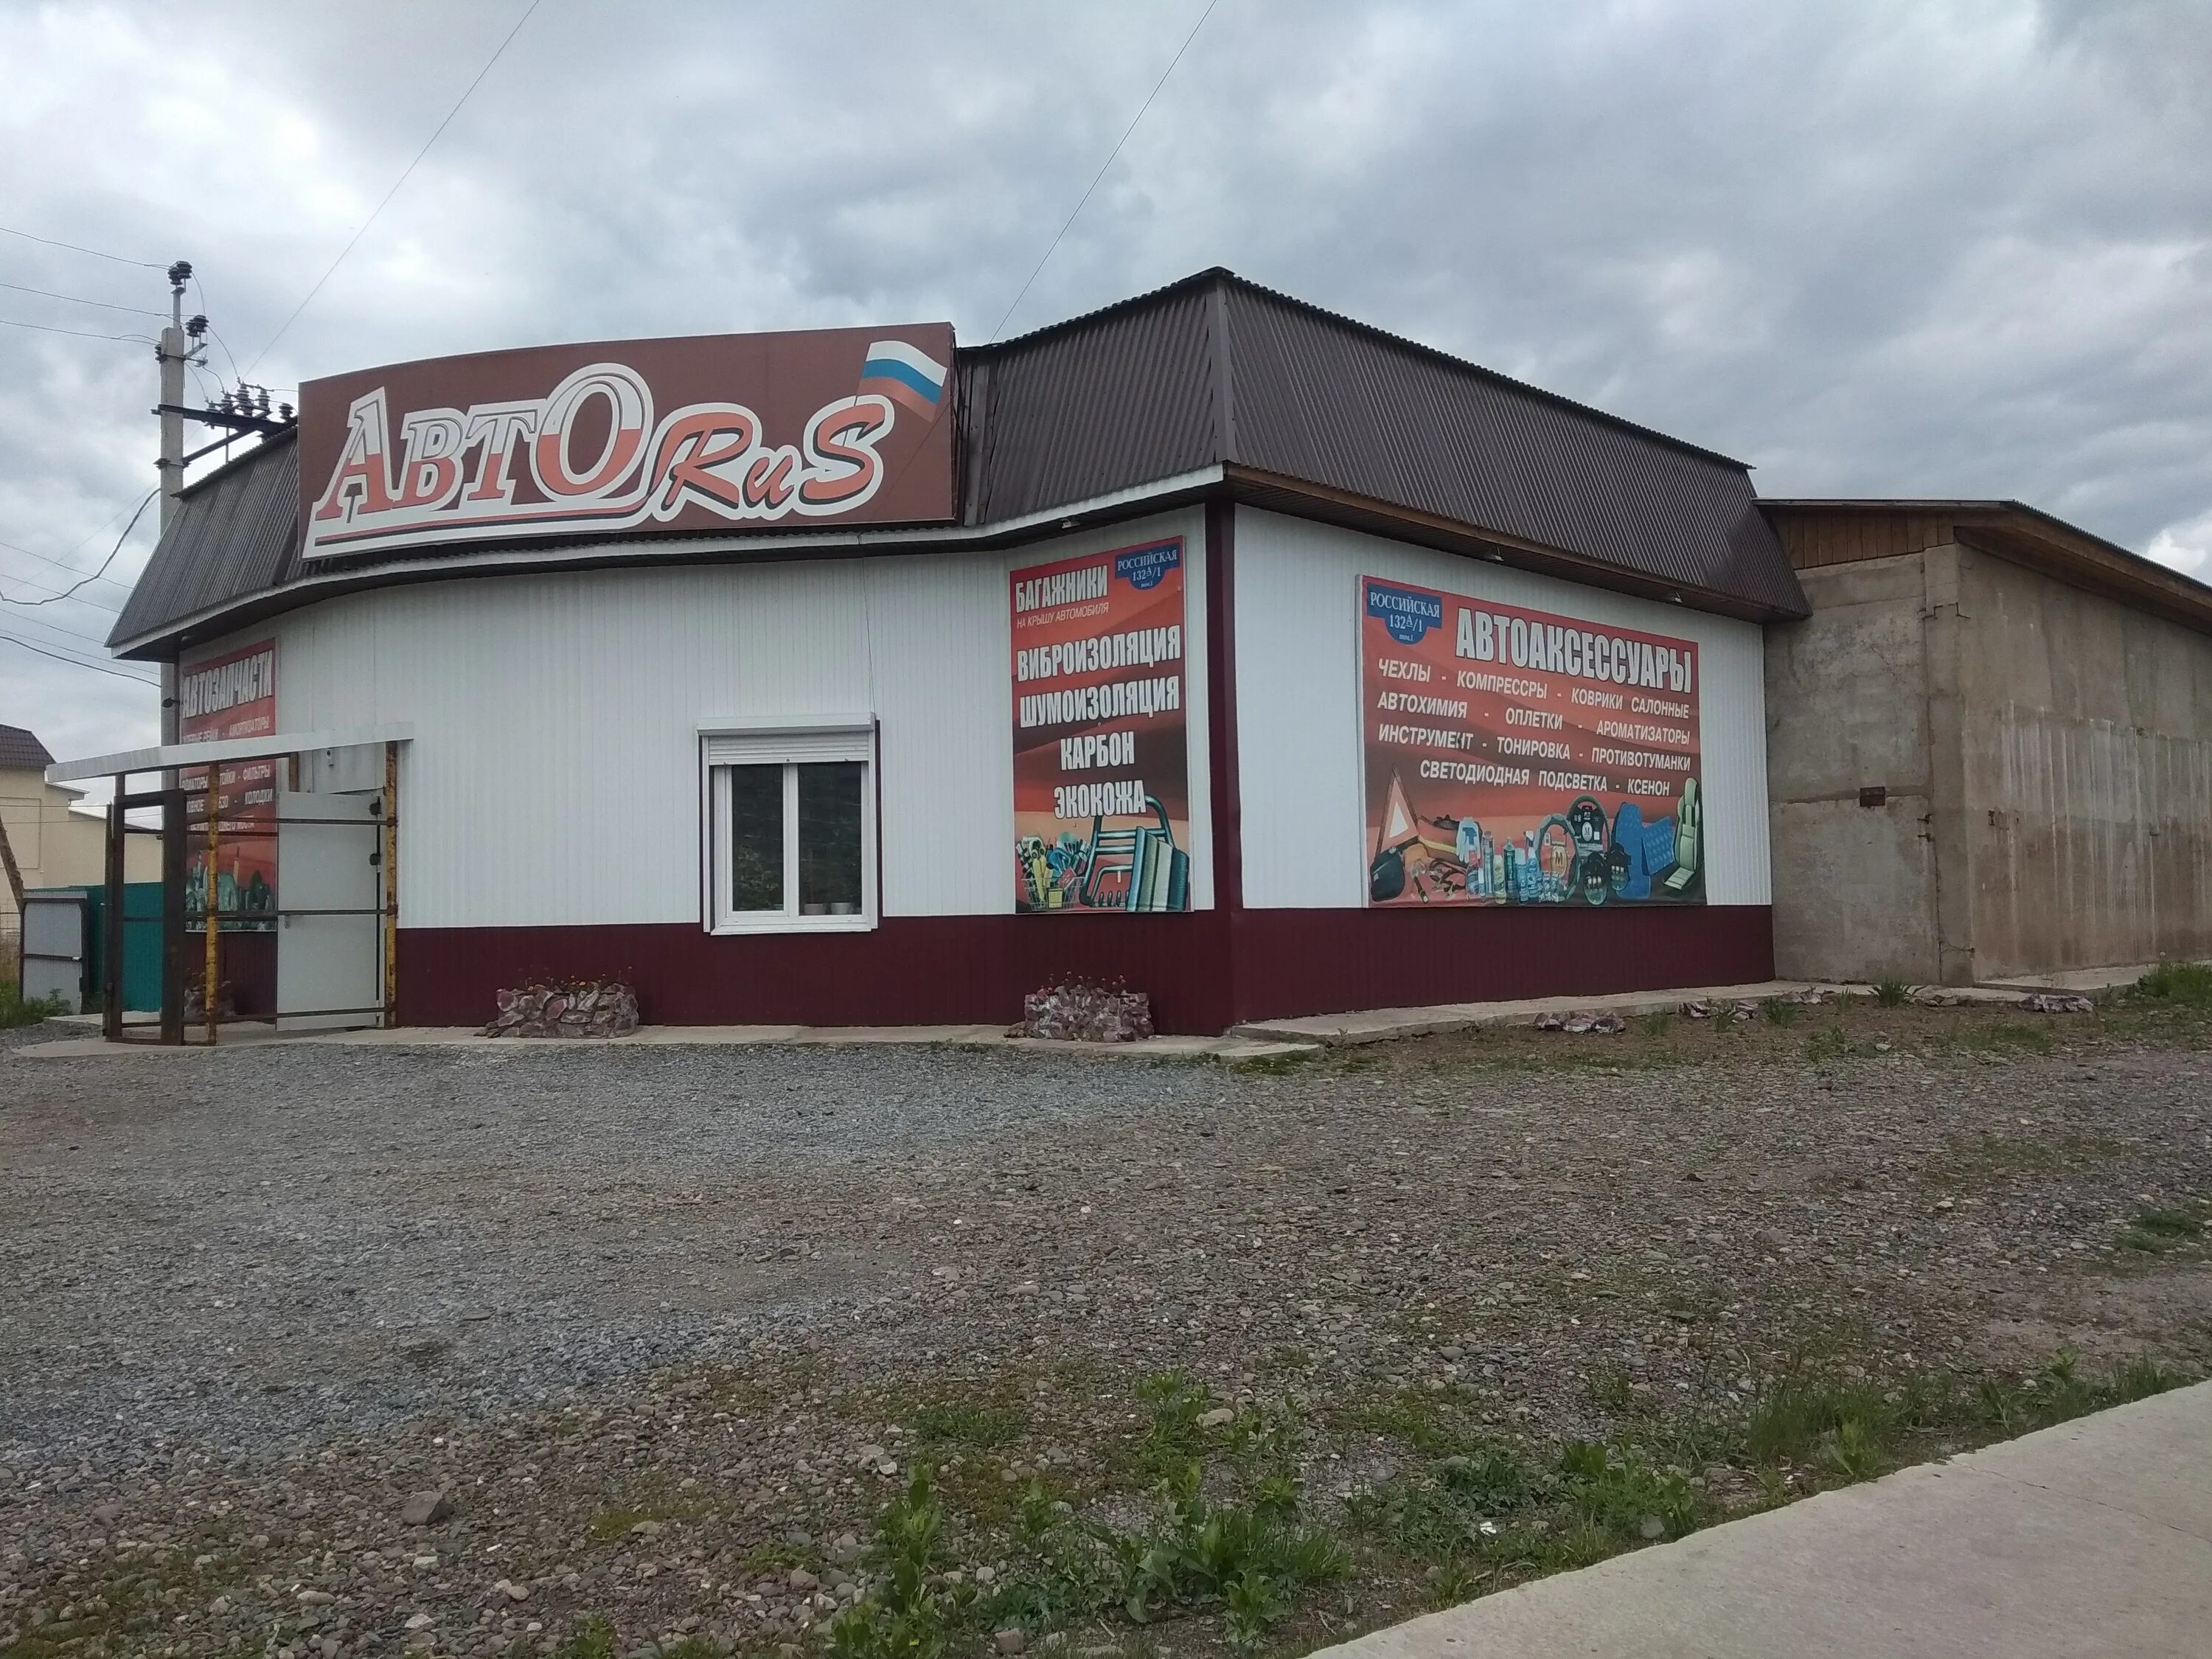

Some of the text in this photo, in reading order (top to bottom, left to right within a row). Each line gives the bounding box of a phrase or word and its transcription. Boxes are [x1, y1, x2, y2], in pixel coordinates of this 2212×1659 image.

[1117, 549, 1178, 571] РОССИЙСКАЯ
[1015, 565, 1107, 613] БАГАЖНИКИ
[1370, 592, 1440, 618] РОССИЙСКАЯ
[1017, 602, 1110, 629] НА КРЫШУ АВТОМОБИЛЯ
[1017, 625, 1180, 682] ВИБРОИЗОЛЯЦИЯ
[1455, 607, 1691, 693] АВТОАКСЕССУАРЫ
[182, 650, 273, 719] АВТОЗАПЧАСТИ
[1020, 675, 1180, 728] ШУМОИЗОЛЯЦИЯ
[1378, 658, 1689, 719] ЧЕХЛЫ КОМПРЕССРЫ КОВРИКИ САЛОННЫЕ
[1377, 691, 1691, 745] АВТОХИМИЯ ОПЛЕТКИ АРОМАТИЗАТОРЫ
[1060, 731, 1135, 771] КАРБОН
[1497, 737, 1571, 759] ТОНИРОВКА
[1592, 747, 1691, 772] ПРОТИВОТУМАНКИ
[243, 764, 271, 782] ФИЛЬТРЫ
[1420, 759, 1671, 796] СВЕТОДИОДНАЯ ПОДСВЕТКА КСЕНОН
[245, 788, 273, 806] КОЛОДКИ
[1054, 779, 1147, 819] ЭКОКОЖА
